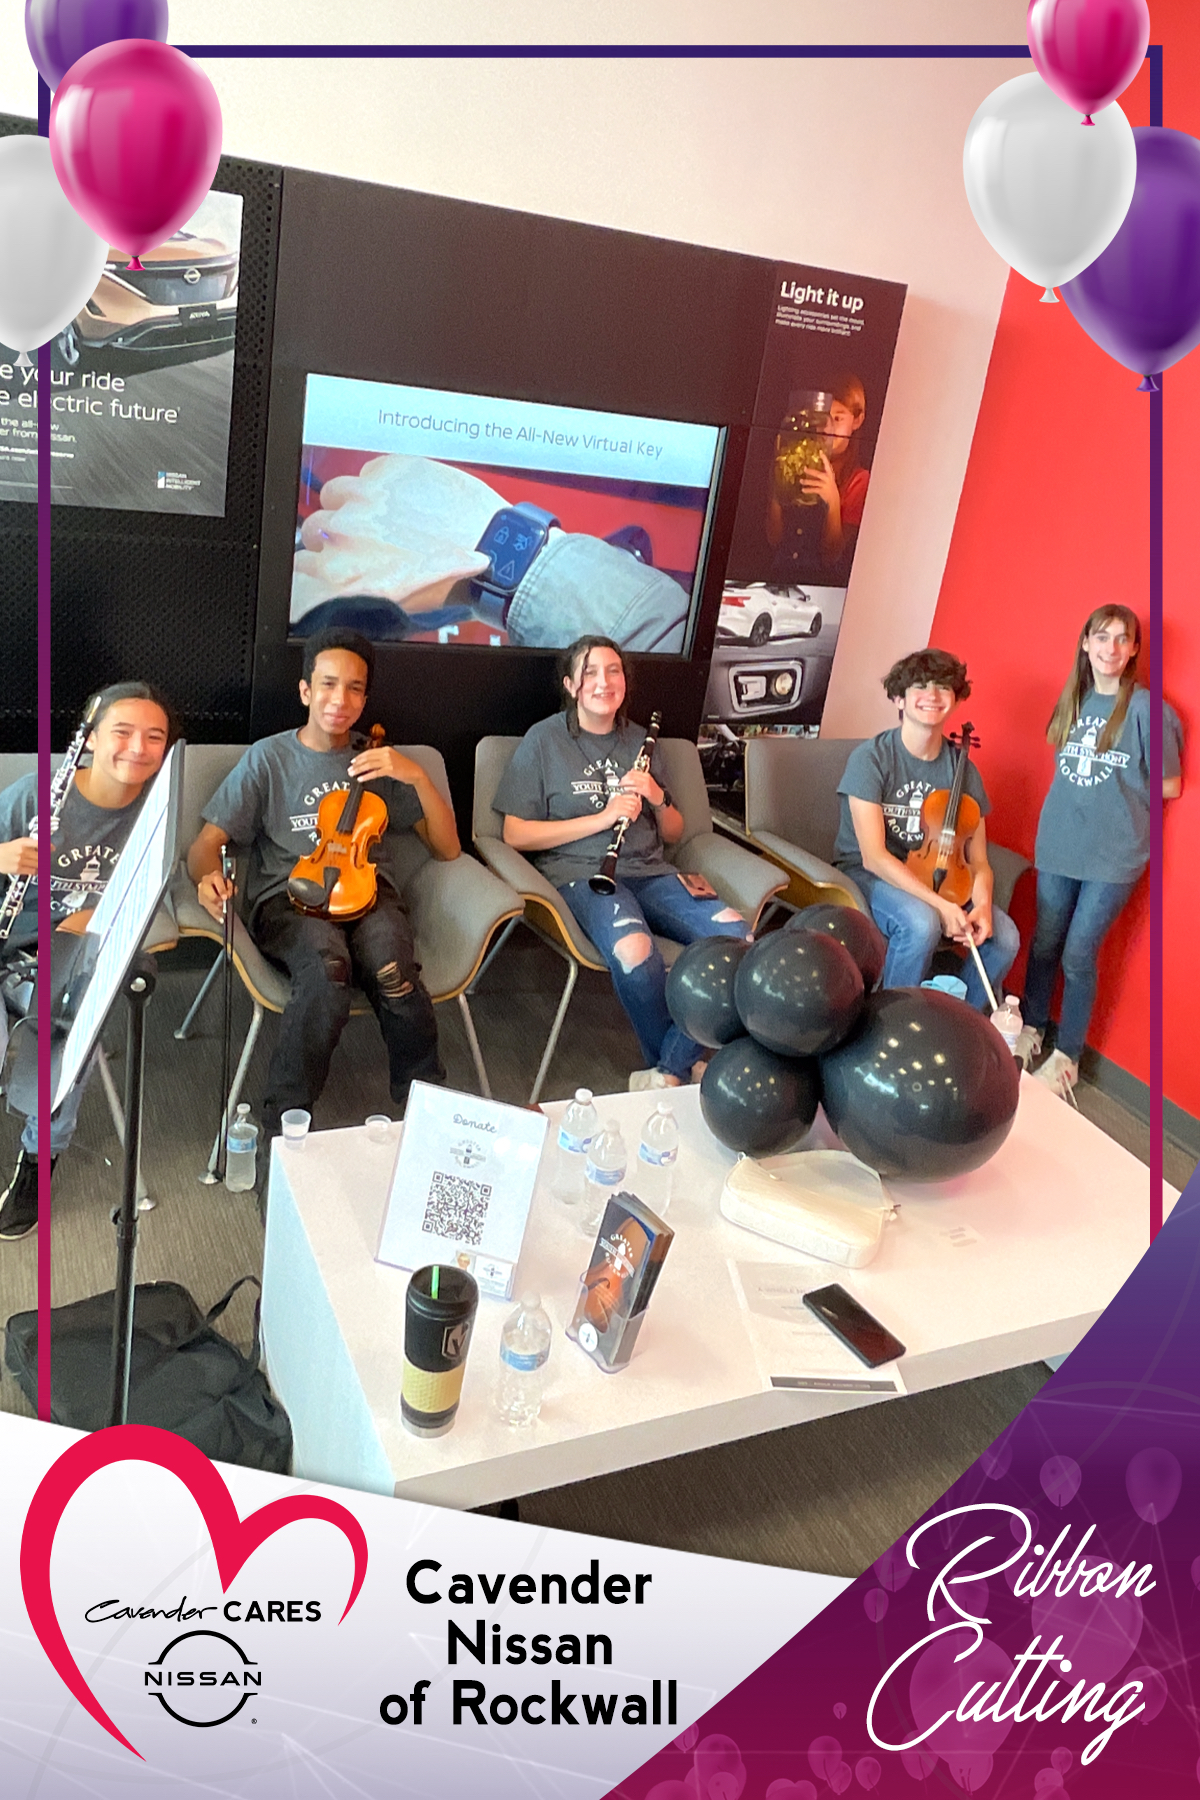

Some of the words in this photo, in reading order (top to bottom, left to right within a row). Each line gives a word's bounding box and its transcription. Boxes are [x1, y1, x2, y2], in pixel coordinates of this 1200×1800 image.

[781, 281, 824, 304] Light
[826, 288, 839, 307] it
[841, 296, 864, 314] up
[20, 366, 74, 386] yur
[82, 371, 125, 392] ride
[18, 390, 103, 416] elctric
[12, 428, 38, 439] from
[22, 419, 59, 431] all-w
[378, 408, 480, 440] Introducing
[485, 423, 513, 440] the
[516, 426, 579, 449] All-New
[582, 434, 633, 455] Virtual
[636, 441, 663, 461] Key
[1070, 716, 1107, 734] REAT
[1059, 757, 1113, 787] ROCKWALL
[304, 781, 350, 805] GREAT
[896, 781, 936, 798] GREAT
[291, 817, 318, 828] YOUT
[883, 807, 908, 817] OUTH
[888, 818, 924, 842] ROCKW
[58, 845, 120, 867] GREATE
[453, 1113, 497, 1134] Donate
